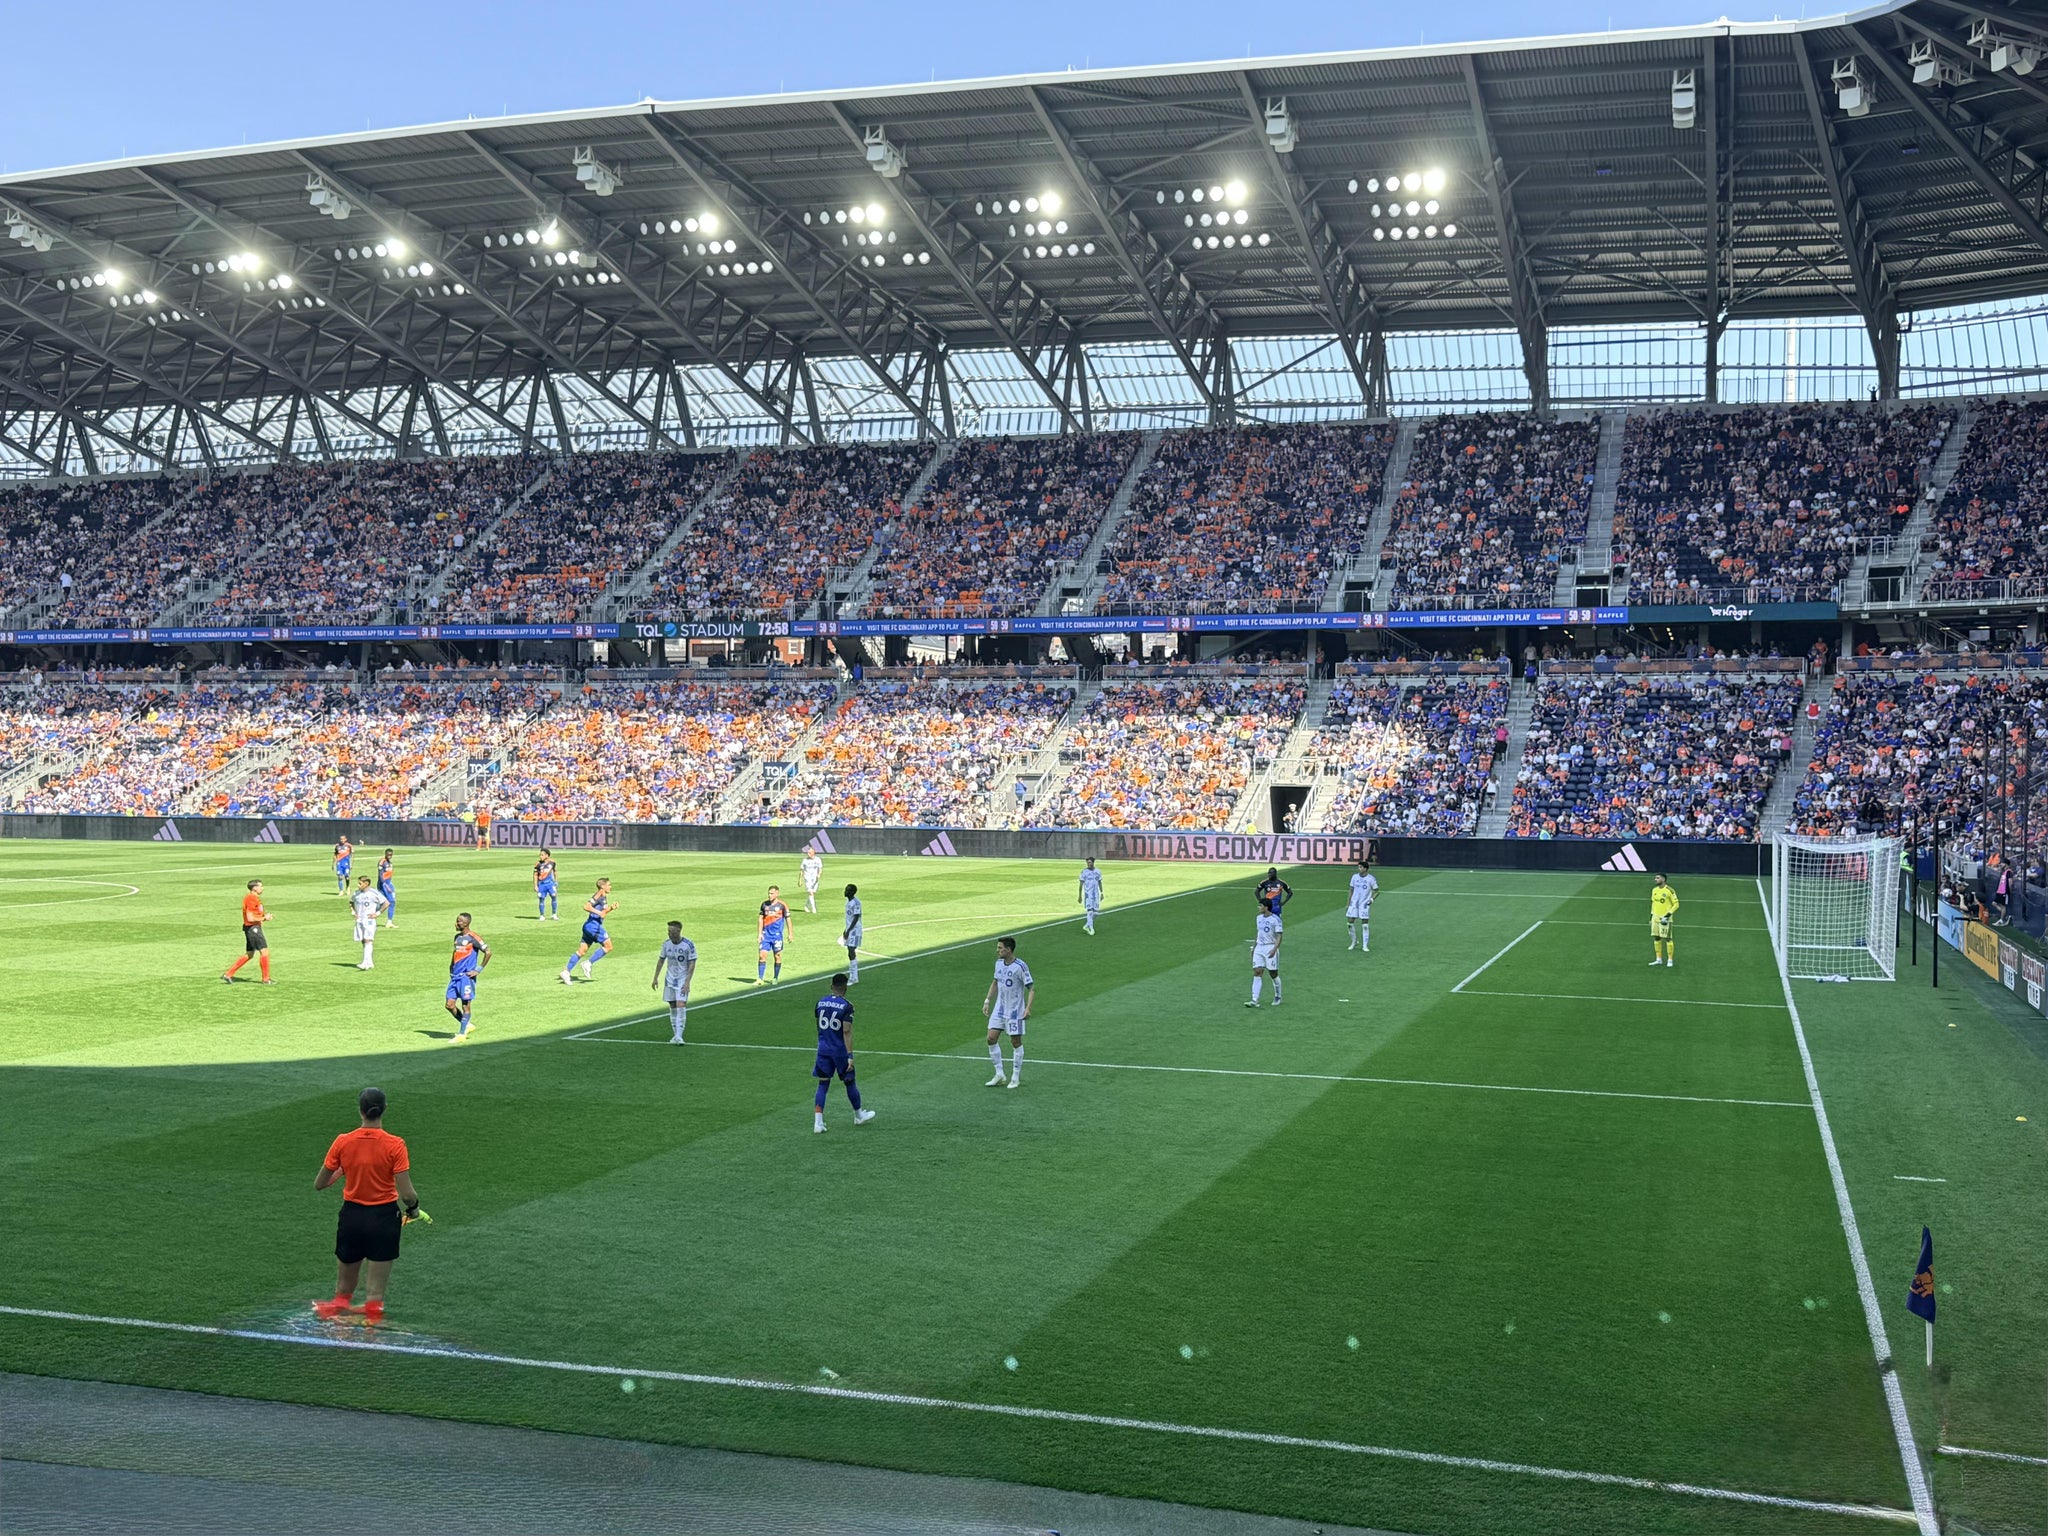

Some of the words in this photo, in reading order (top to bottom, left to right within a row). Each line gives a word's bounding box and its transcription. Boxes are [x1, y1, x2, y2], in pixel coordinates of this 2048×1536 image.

[1492, 614, 1504, 622] APP
[1569, 610, 1577, 621] 50
[1581, 610, 1591, 621] 50
[1723, 605, 1753, 621] Kroger
[1363, 614, 1371, 625] 50
[1375, 614, 1383, 625] 50
[635, 624, 663, 637] TQL
[681, 623, 744, 637] STADIUM
[758, 623, 789, 635] 72:58
[464, 985, 472, 994] 5
[819, 1009, 841, 1031] 66
[1009, 1022, 1018, 1032] 13
